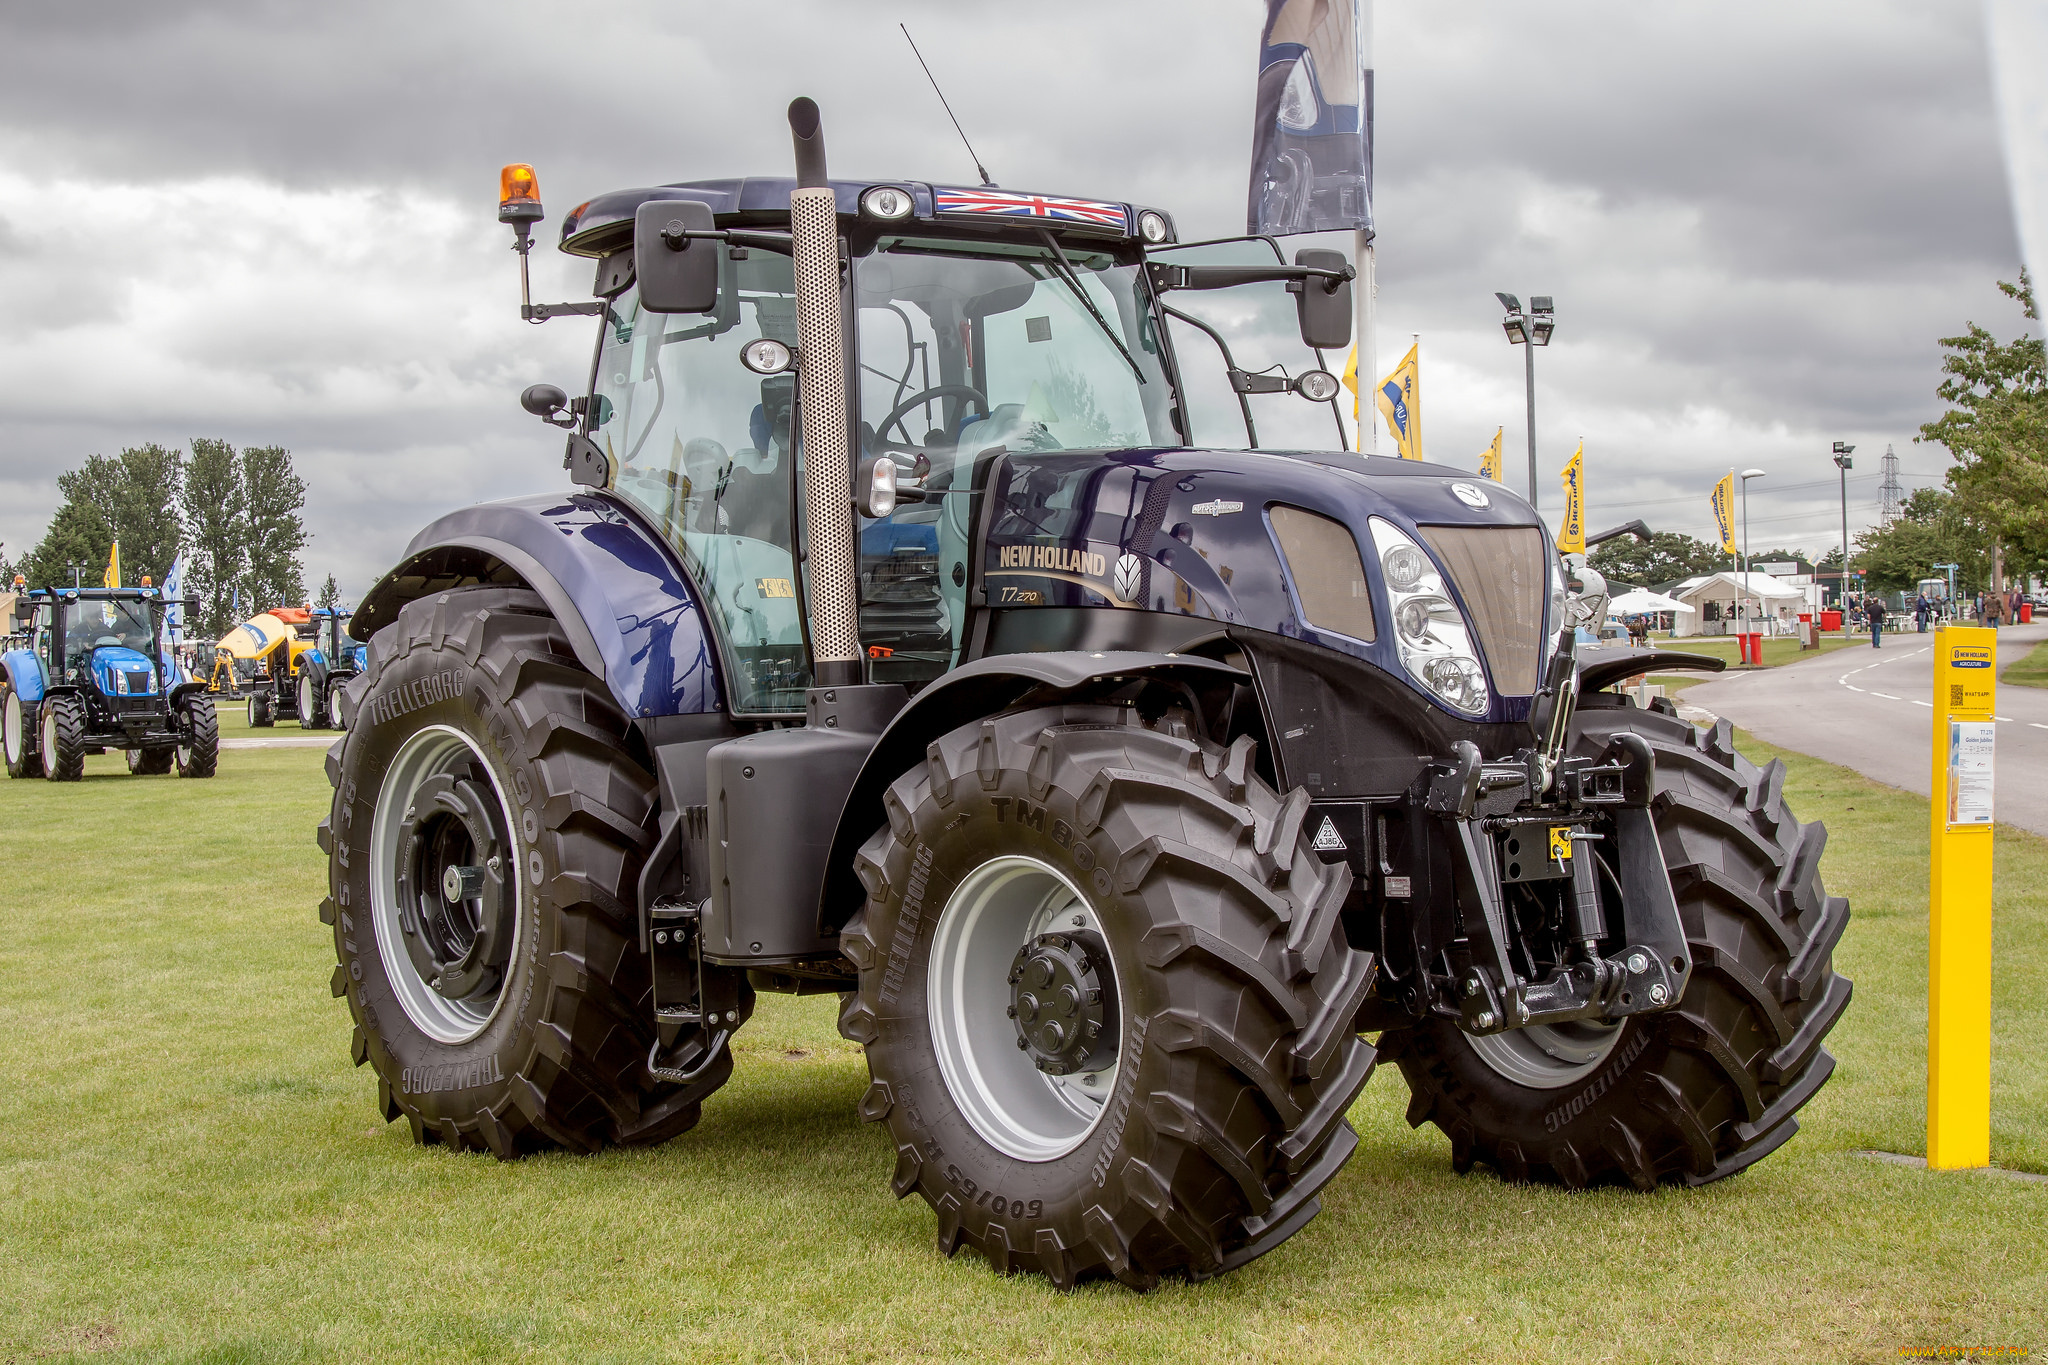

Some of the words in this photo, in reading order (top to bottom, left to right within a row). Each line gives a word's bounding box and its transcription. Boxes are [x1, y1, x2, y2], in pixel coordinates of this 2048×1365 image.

[1000, 545, 1032, 568] NEW
[1033, 545, 1106, 577] HOLLAND
[1001, 586, 1037, 602] T7.270
[369, 668, 464, 726] TRELLEBORG
[1323, 829, 1332, 837] 21
[878, 842, 934, 1006] TRELLEBORG
[402, 1052, 505, 1094] TRELLEBORG
[1545, 1027, 1650, 1133] TRELLEBORG
[1091, 1013, 1151, 1189] TRELLEBORG
